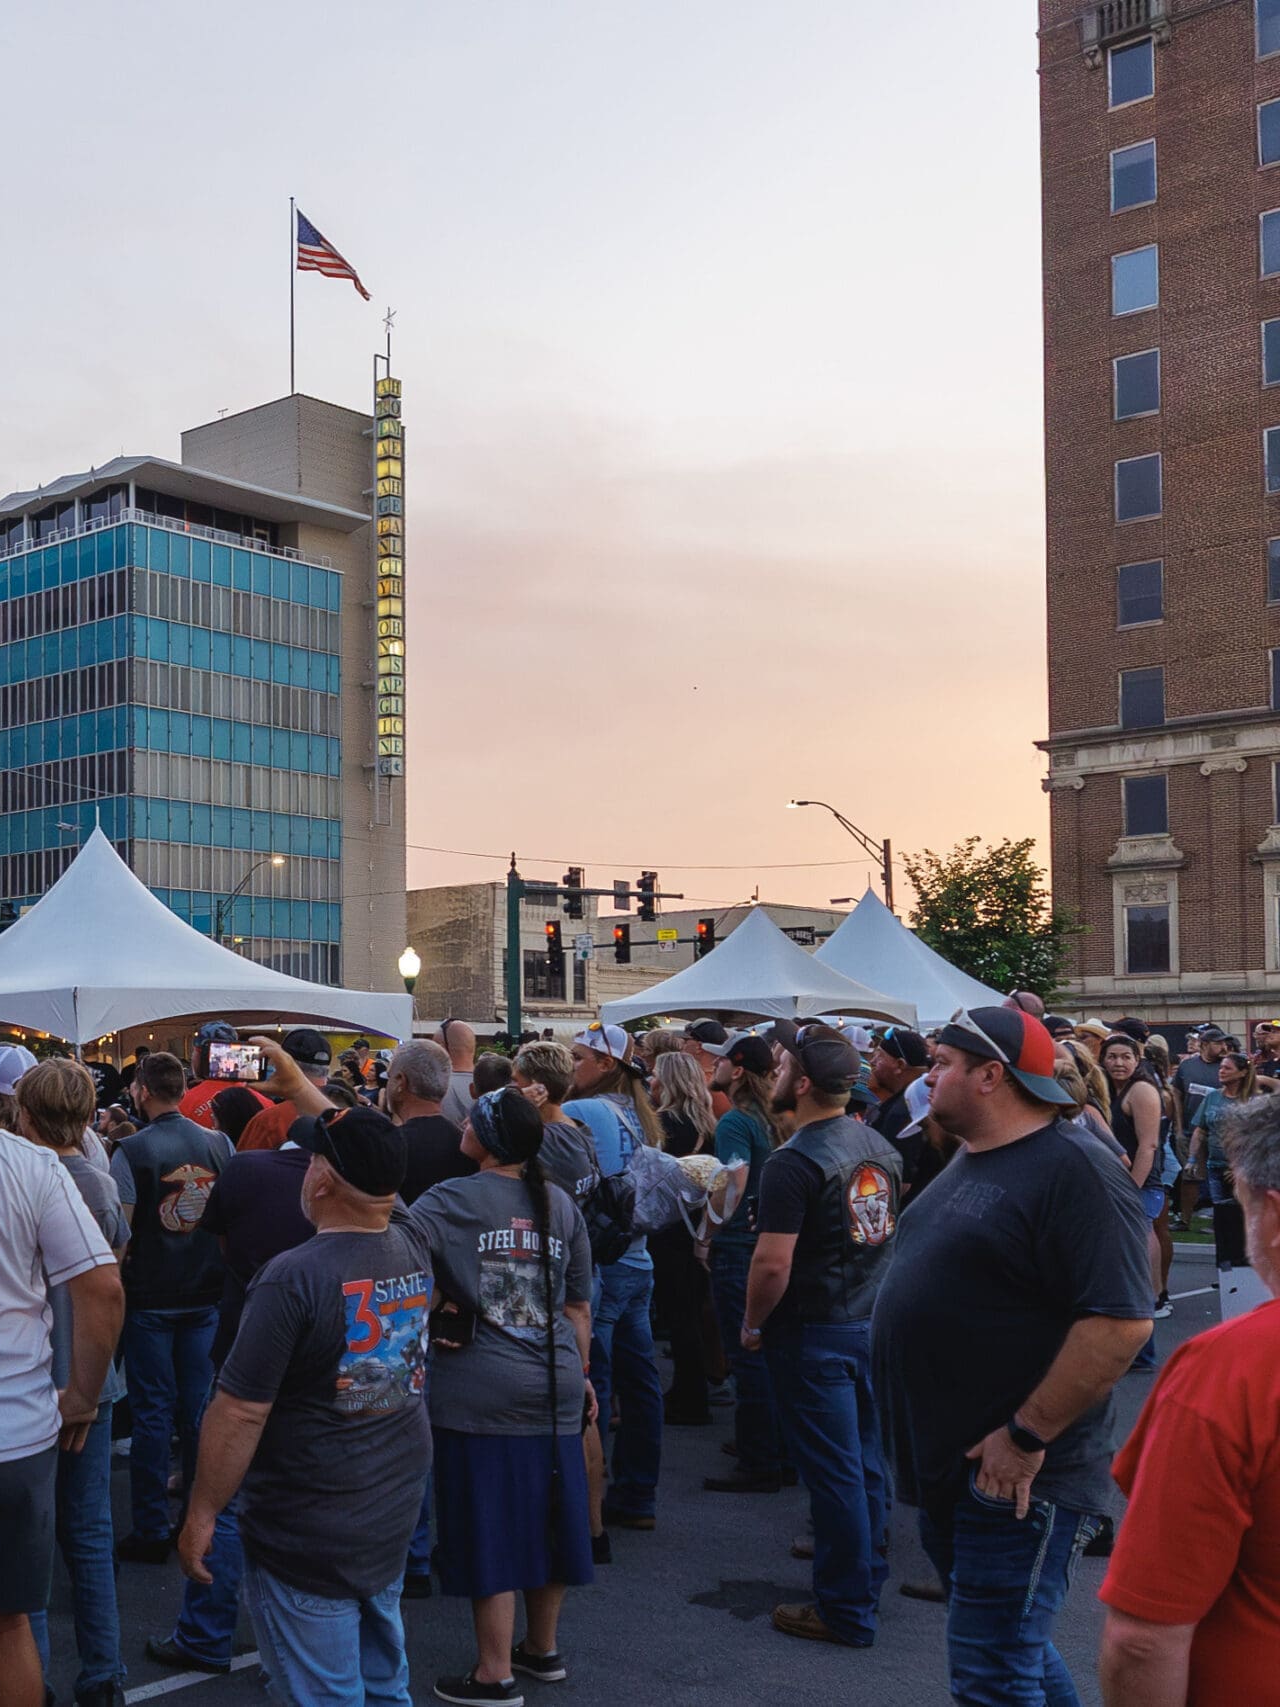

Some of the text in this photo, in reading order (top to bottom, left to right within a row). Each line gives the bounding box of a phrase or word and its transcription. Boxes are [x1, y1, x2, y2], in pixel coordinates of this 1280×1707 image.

[377, 380, 390, 774] AREA AGENCY ON AGING
[391, 380, 402, 754] HOME HEALTH HSPICE
[341, 1271, 427, 1354] 3 STATE
[477, 1229, 563, 1260] STEEL HOSE
